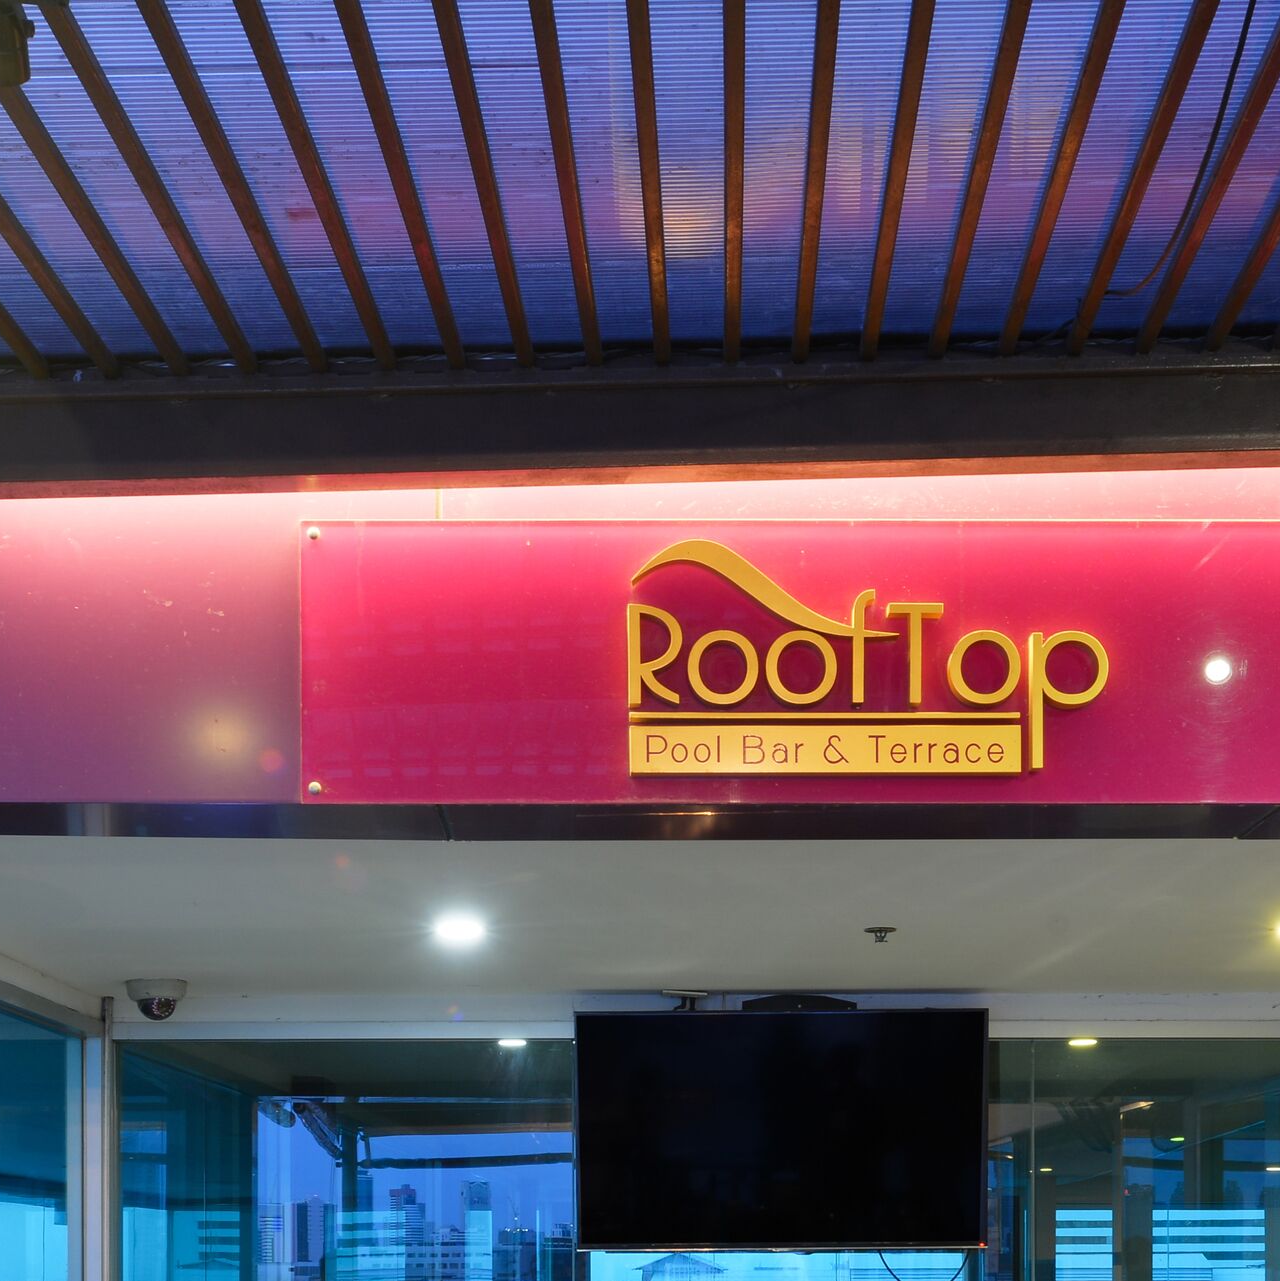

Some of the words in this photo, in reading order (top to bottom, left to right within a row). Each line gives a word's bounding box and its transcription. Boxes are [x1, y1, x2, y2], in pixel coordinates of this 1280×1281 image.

[627, 586, 1110, 771] RoofTop
[645, 734, 722, 765] Pool
[742, 734, 805, 765] Bar
[822, 734, 851, 765] &
[868, 734, 1006, 765] Terrace
